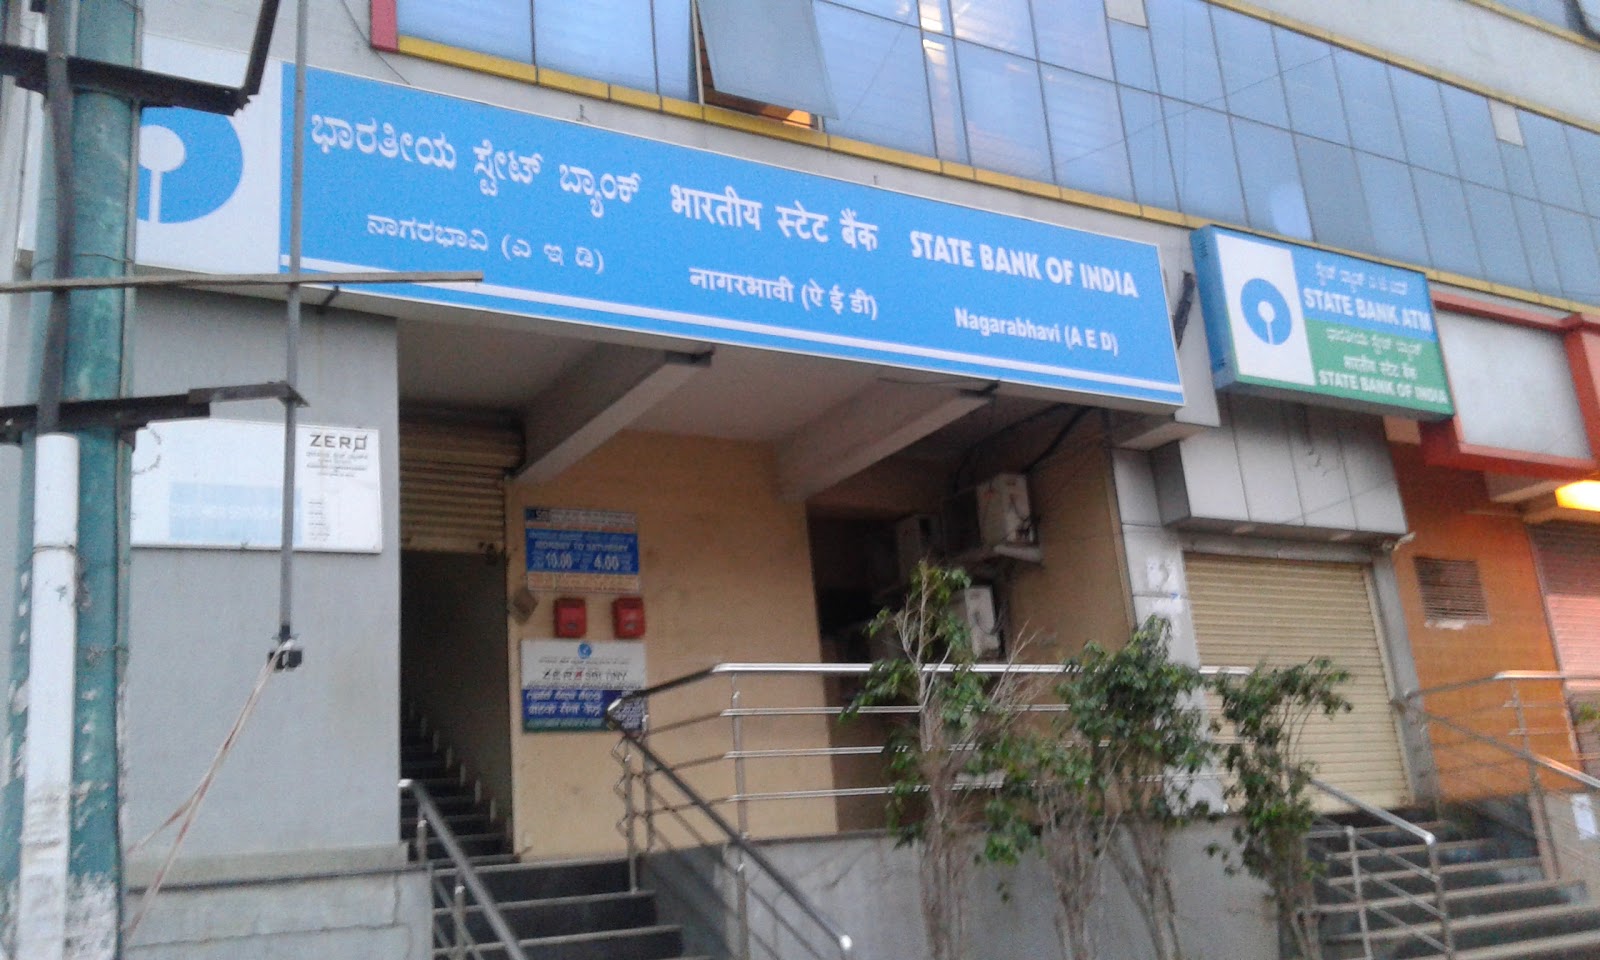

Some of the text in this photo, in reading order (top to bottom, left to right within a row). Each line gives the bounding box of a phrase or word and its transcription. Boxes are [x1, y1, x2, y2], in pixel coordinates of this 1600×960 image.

[312, 115, 641, 218] ಭಾರತೀಯ ಸ್ಟೇಟ್ ಬ್ಯಾಂಕ್
[670, 184, 878, 251] भारतीय स्टेट बैंक
[910, 231, 1138, 298] STATE BANK OF INDIA
[689, 268, 795, 302] नागरभावी
[829, 285, 844, 314] ई
[849, 288, 877, 320] डी)
[1305, 288, 1432, 331] STATE BANK ATM
[955, 307, 1118, 356] Nagarabhavi (A E D)
[310, 433, 368, 452] ZERO
